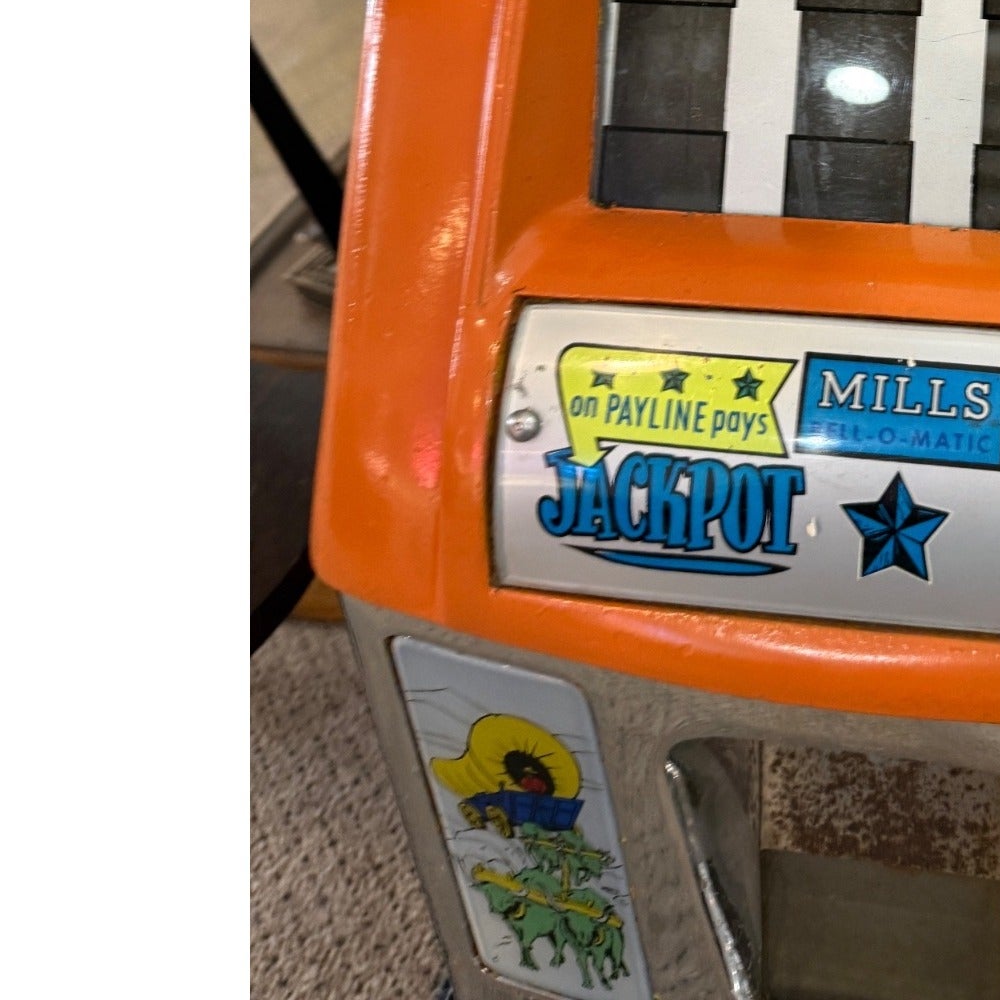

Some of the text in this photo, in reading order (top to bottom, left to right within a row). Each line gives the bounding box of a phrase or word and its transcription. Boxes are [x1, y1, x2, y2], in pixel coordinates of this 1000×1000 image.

[569, 393, 769, 441] on PAYLINE pays
[817, 369, 991, 421] MILLS
[536, 444, 806, 555] JACKPOT
